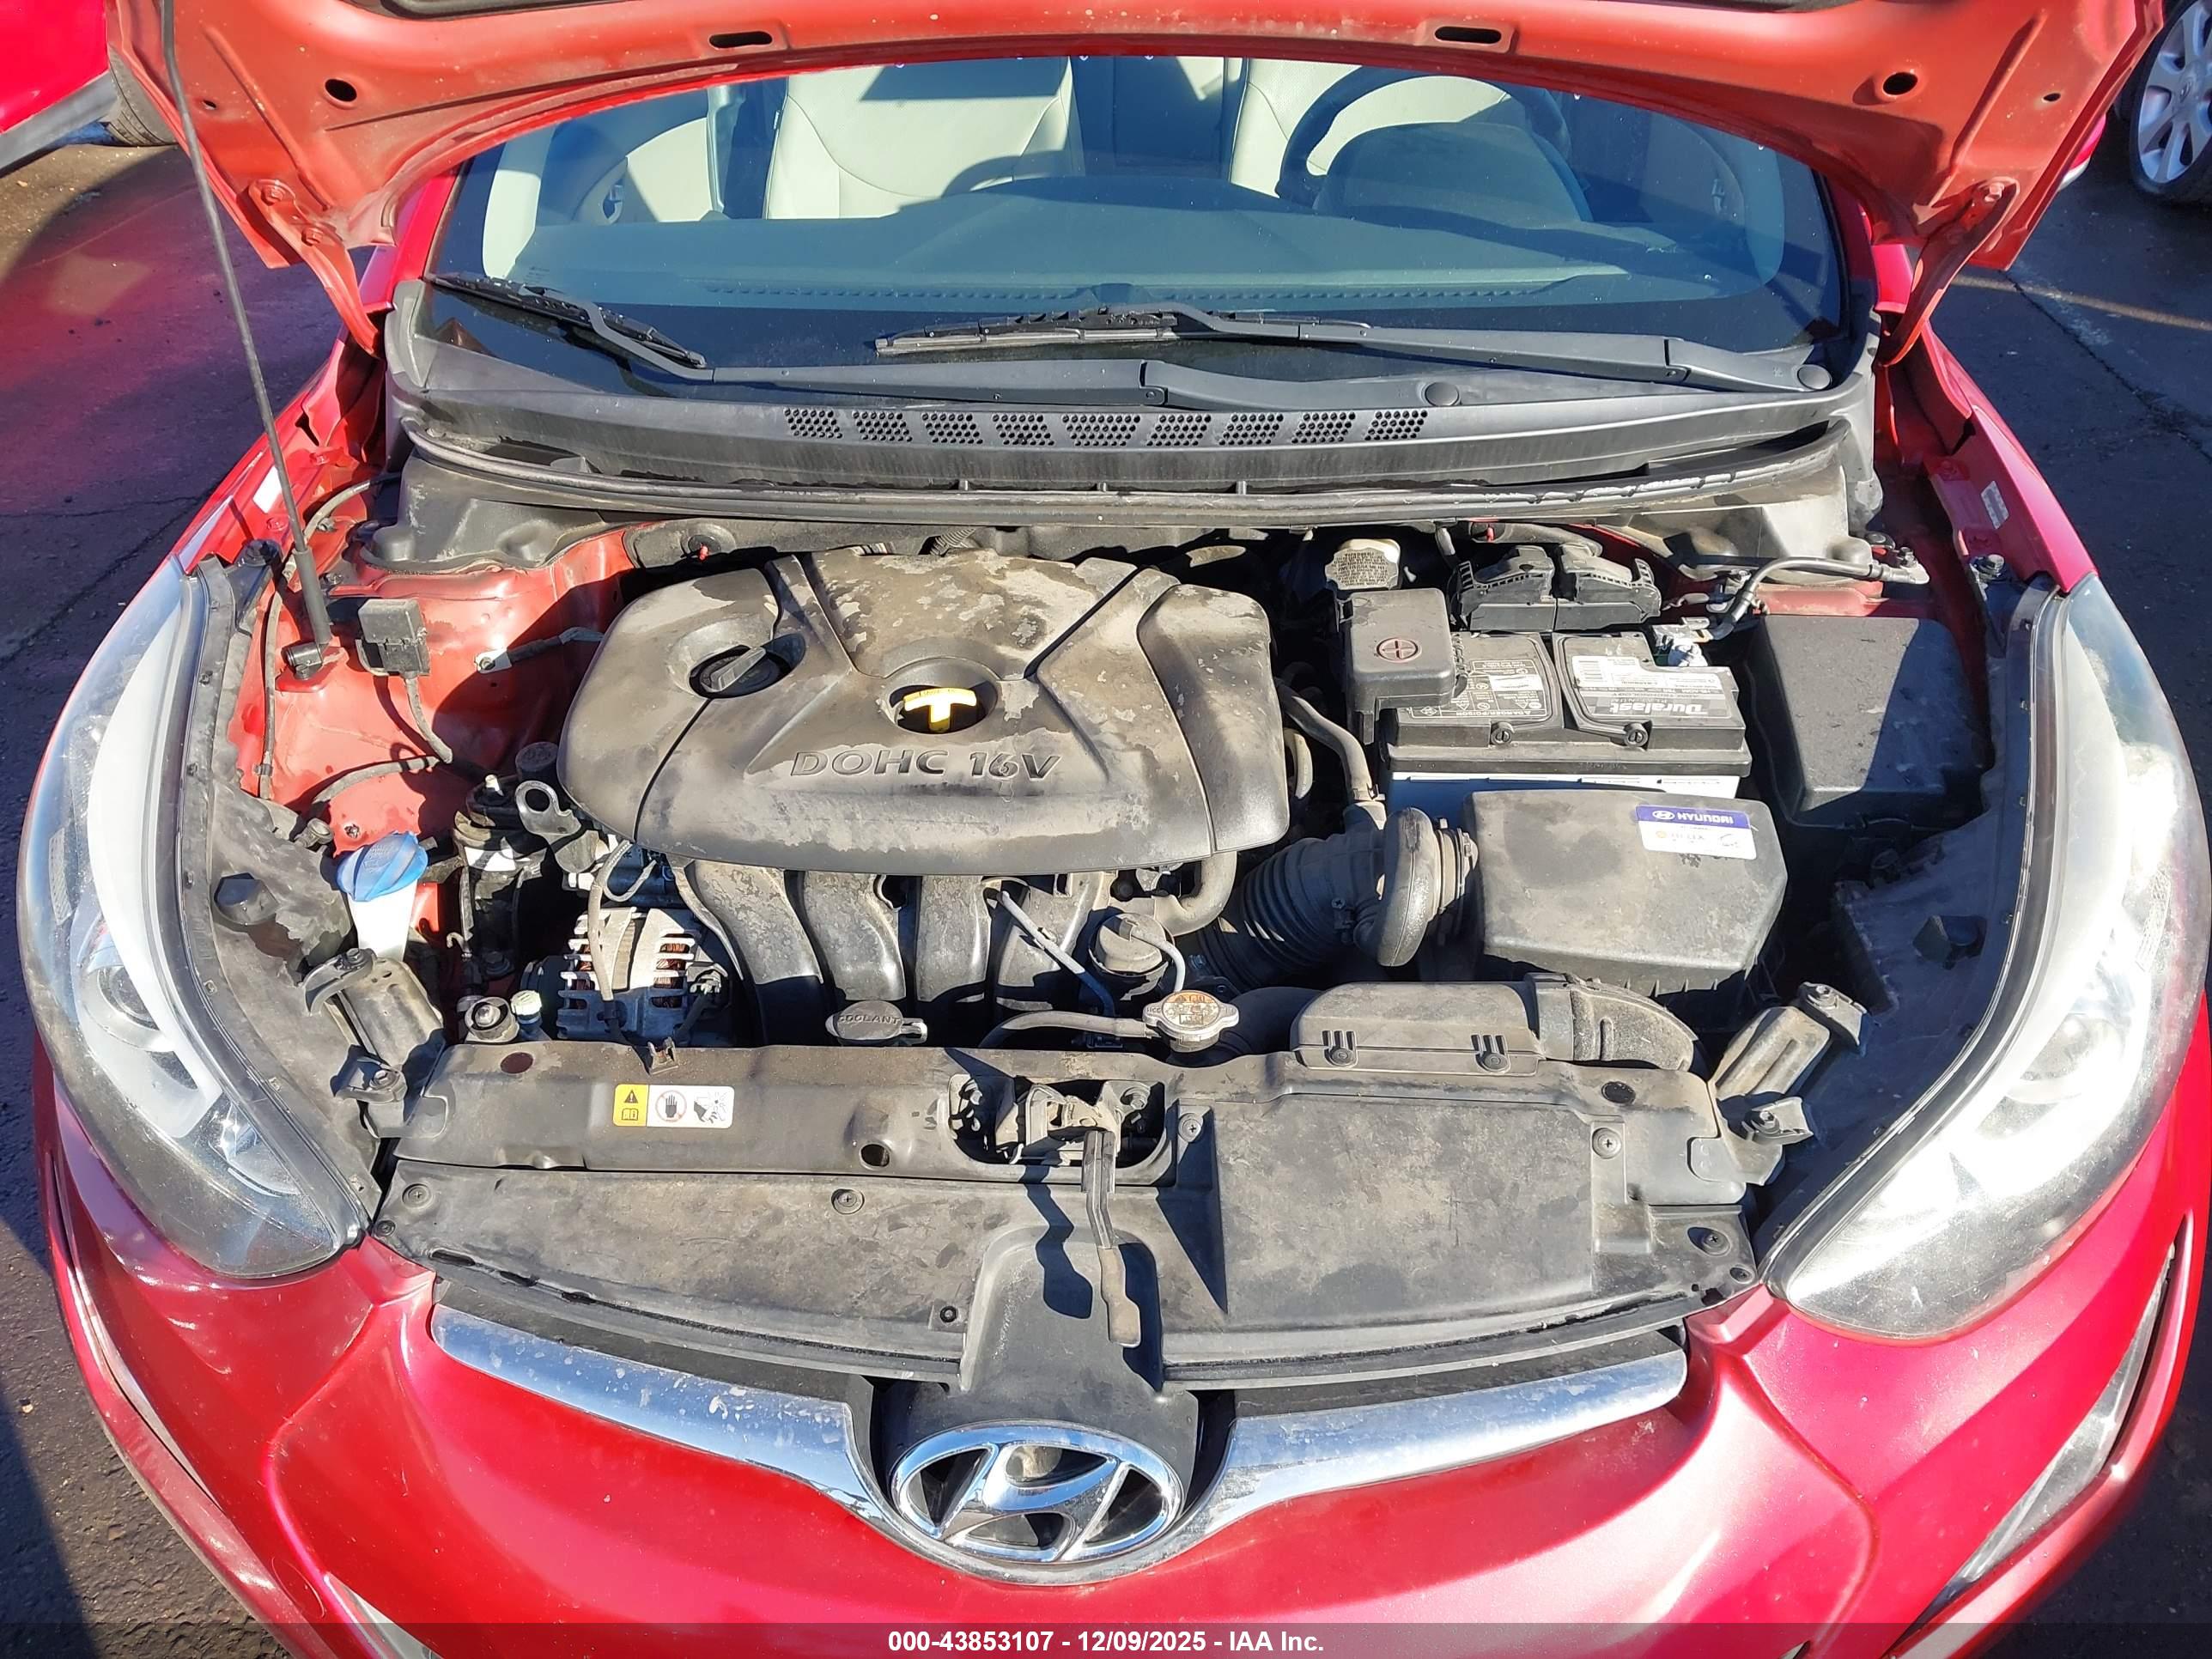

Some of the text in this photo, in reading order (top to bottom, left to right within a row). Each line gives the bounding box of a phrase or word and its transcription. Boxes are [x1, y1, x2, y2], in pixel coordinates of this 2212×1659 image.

[1609, 702, 1708, 715] Duralast
[790, 749, 1062, 781] DOHC 16V
[1677, 812, 1734, 824] HYUNDAI
[837, 1014, 902, 1025] COOLANT
